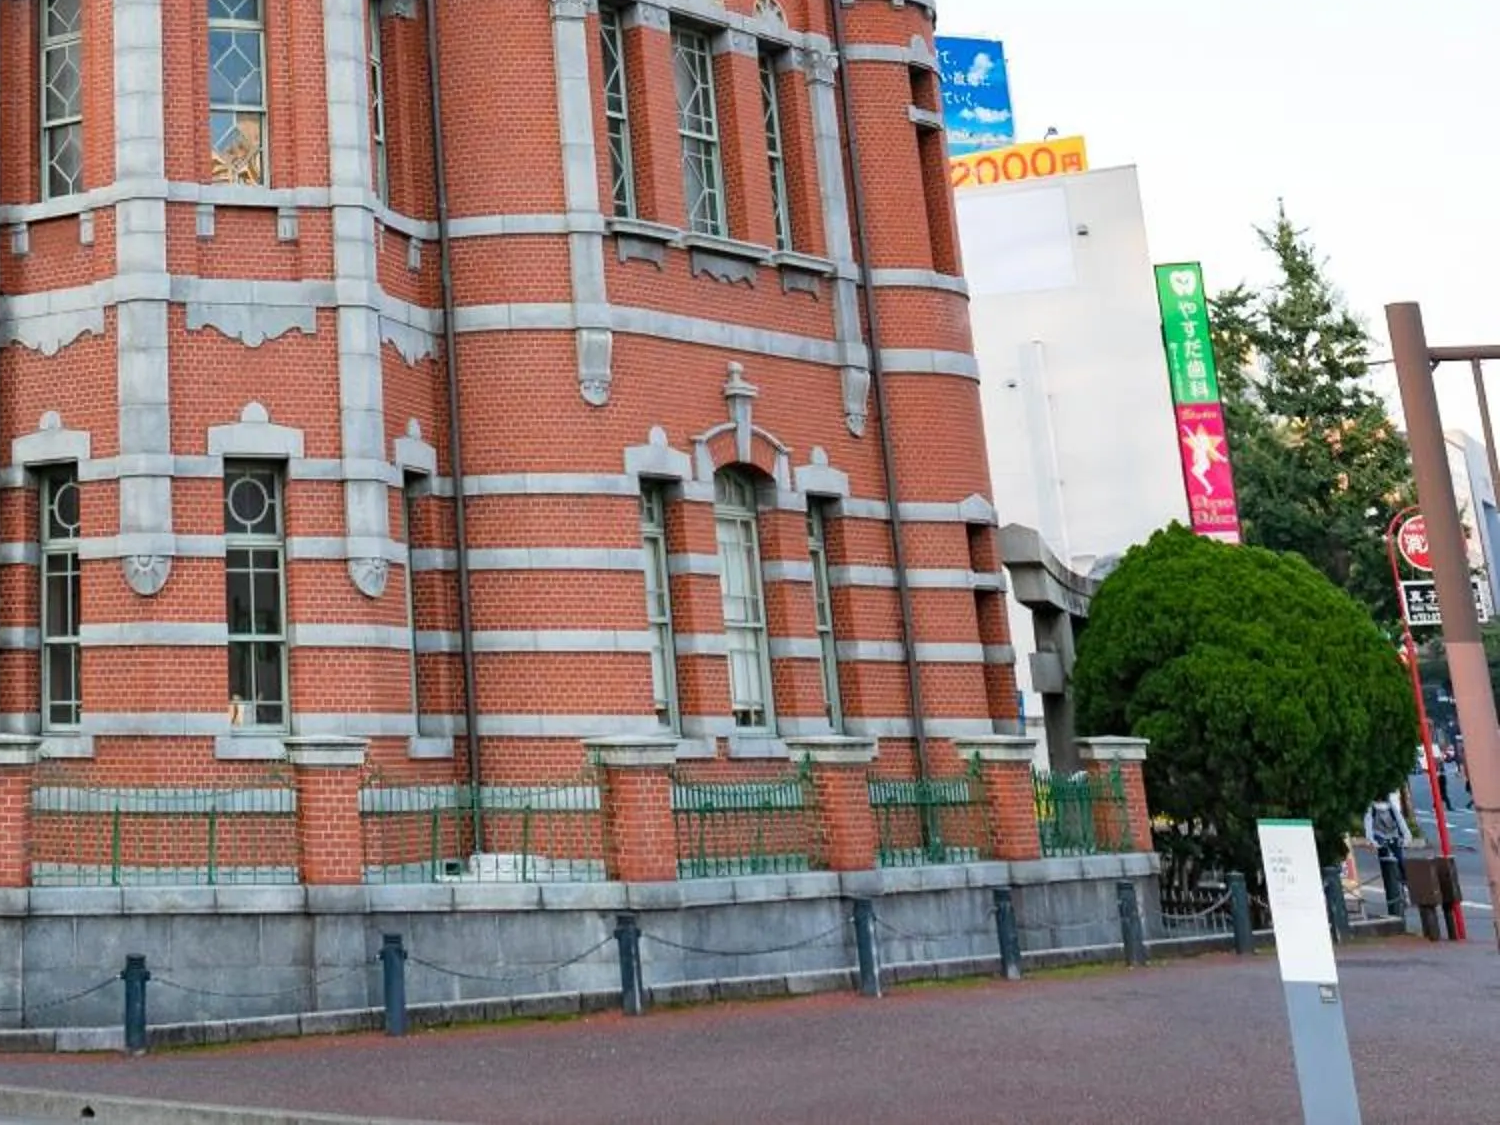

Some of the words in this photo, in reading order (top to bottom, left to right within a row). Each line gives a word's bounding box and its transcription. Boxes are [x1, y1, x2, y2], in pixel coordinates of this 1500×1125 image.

[1179, 300, 1209, 399] やすだ歯科
